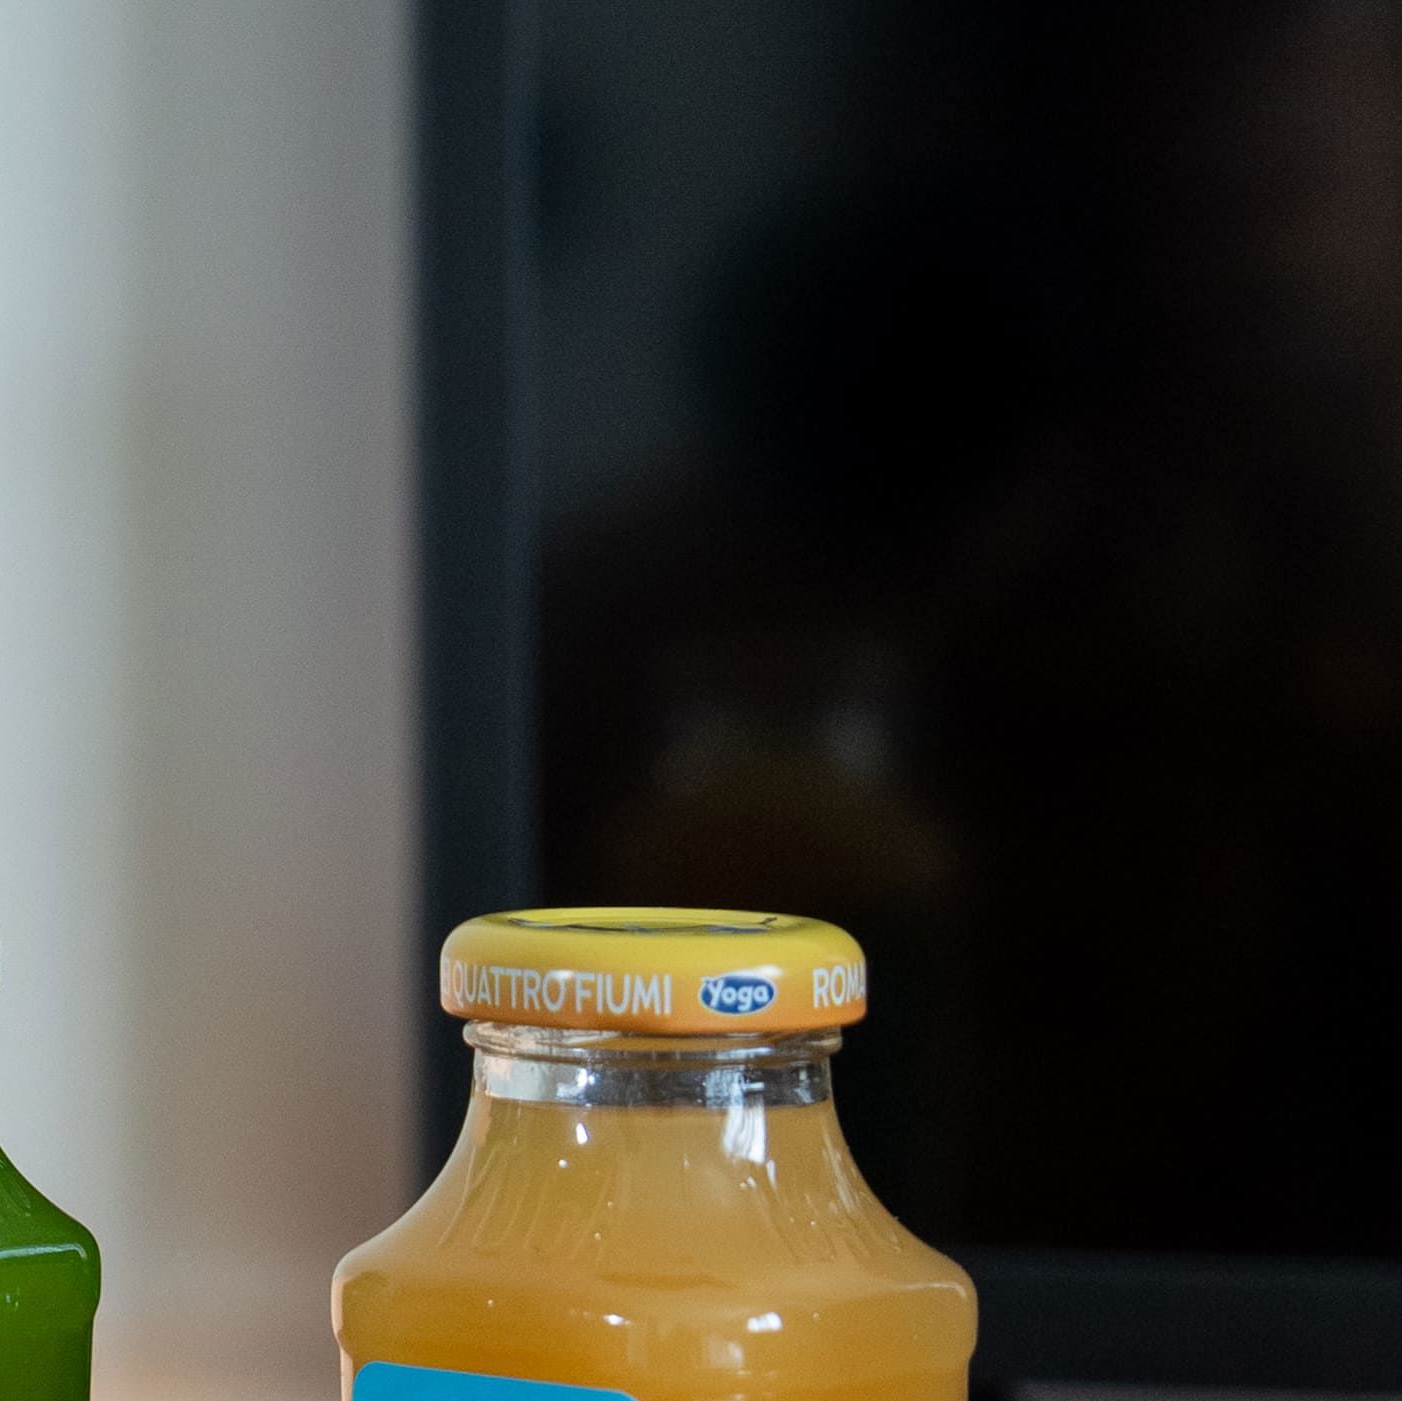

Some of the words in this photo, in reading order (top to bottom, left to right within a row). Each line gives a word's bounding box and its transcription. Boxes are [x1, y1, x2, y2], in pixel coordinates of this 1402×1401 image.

[452, 960, 568, 1013] QUATTRO
[574, 971, 673, 1015] FIUMI
[702, 976, 772, 1012] Yoga
